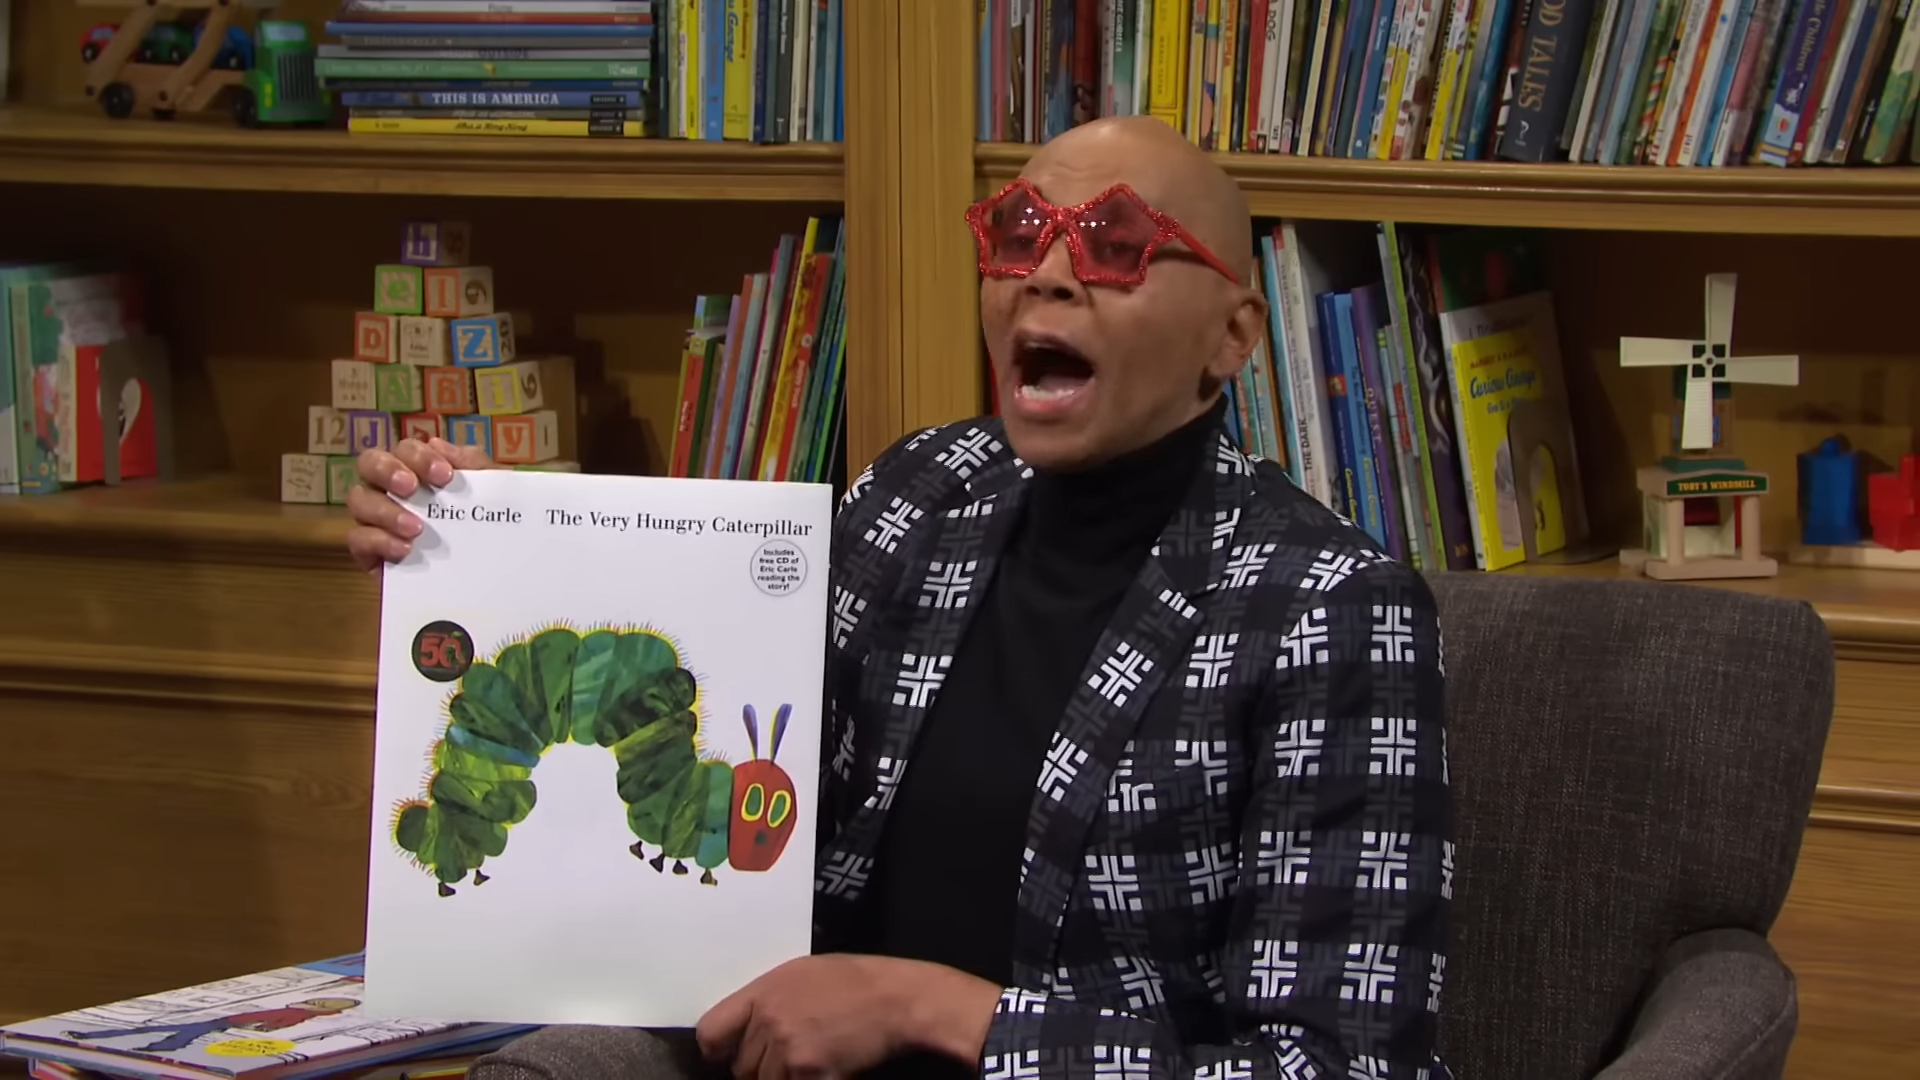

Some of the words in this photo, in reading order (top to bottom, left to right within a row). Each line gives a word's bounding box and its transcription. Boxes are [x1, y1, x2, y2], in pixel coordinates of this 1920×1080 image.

[1265, 9, 1277, 42] DOG
[1795, 17, 1822, 73] Children
[1518, 34, 1558, 112] TALES
[432, 93, 468, 105] THIS
[472, 93, 487, 105] IS
[490, 93, 560, 105] AMERICA
[363, 327, 383, 349] D
[462, 328, 488, 358] Z
[793, 359, 806, 386] puppy
[1365, 387, 1382, 444] QUEST
[314, 416, 346, 445] 12
[361, 420, 379, 448] J
[1298, 417, 1311, 449] DARK
[1304, 450, 1314, 472] THE
[1677, 481, 1708, 491] TOBY'S
[1710, 479, 1757, 490] WINDMILL
[427, 503, 466, 521] Eric
[471, 505, 523, 524] Carle
[545, 508, 583, 526] The
[590, 511, 630, 532] Very
[637, 513, 706, 536] Hungry
[712, 516, 813, 538] Caterpillar
[763, 548, 795, 556] Includes
[757, 575, 786, 583] reading
[768, 583, 790, 591] story!
